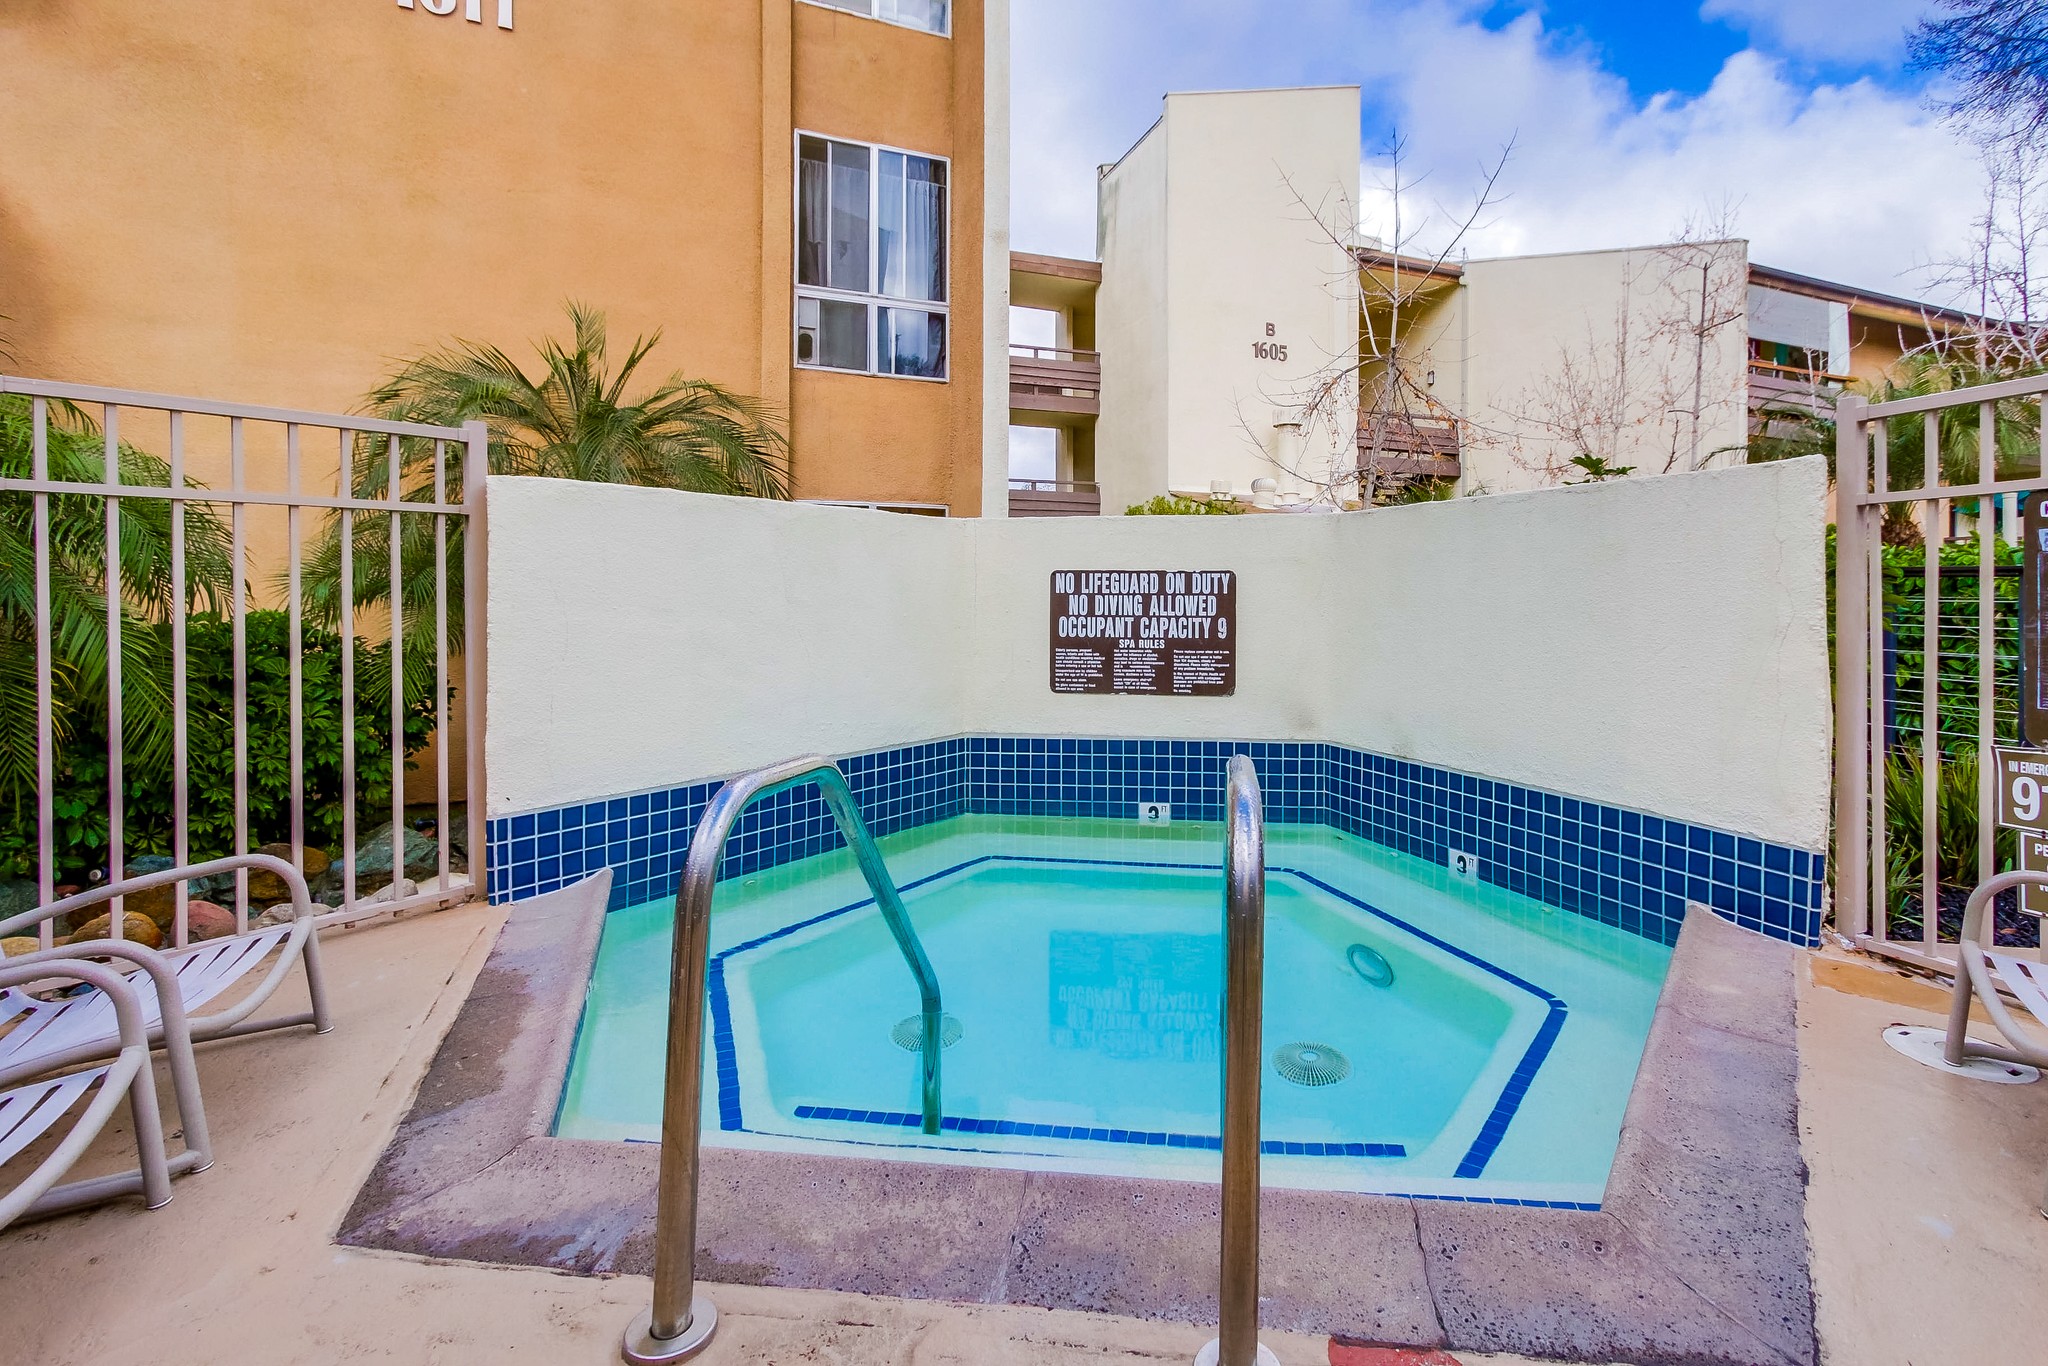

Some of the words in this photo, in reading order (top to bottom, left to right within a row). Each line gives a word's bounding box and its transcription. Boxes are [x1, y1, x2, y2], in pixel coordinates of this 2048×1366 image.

[1266, 322, 1275, 336] B
[1252, 341, 1288, 362] 1605
[1055, 572, 1075, 594] NO
[1081, 572, 1159, 594] LIFEGUARD
[1165, 572, 1185, 594] ON
[1192, 572, 1230, 595] DUTY
[1068, 594, 1088, 616] NO
[1094, 594, 1143, 617] DIVING
[1149, 595, 1217, 617] ALLOWED
[1058, 616, 1134, 638] OCCUPANT
[1140, 616, 1212, 639] CAPACITY
[1217, 617, 1228, 639] 9
[1118, 639, 1135, 649] SPA
[1138, 639, 1166, 649] RULES
[2008, 760, 2019, 773] IN
[1468, 857, 1475, 868] FT
